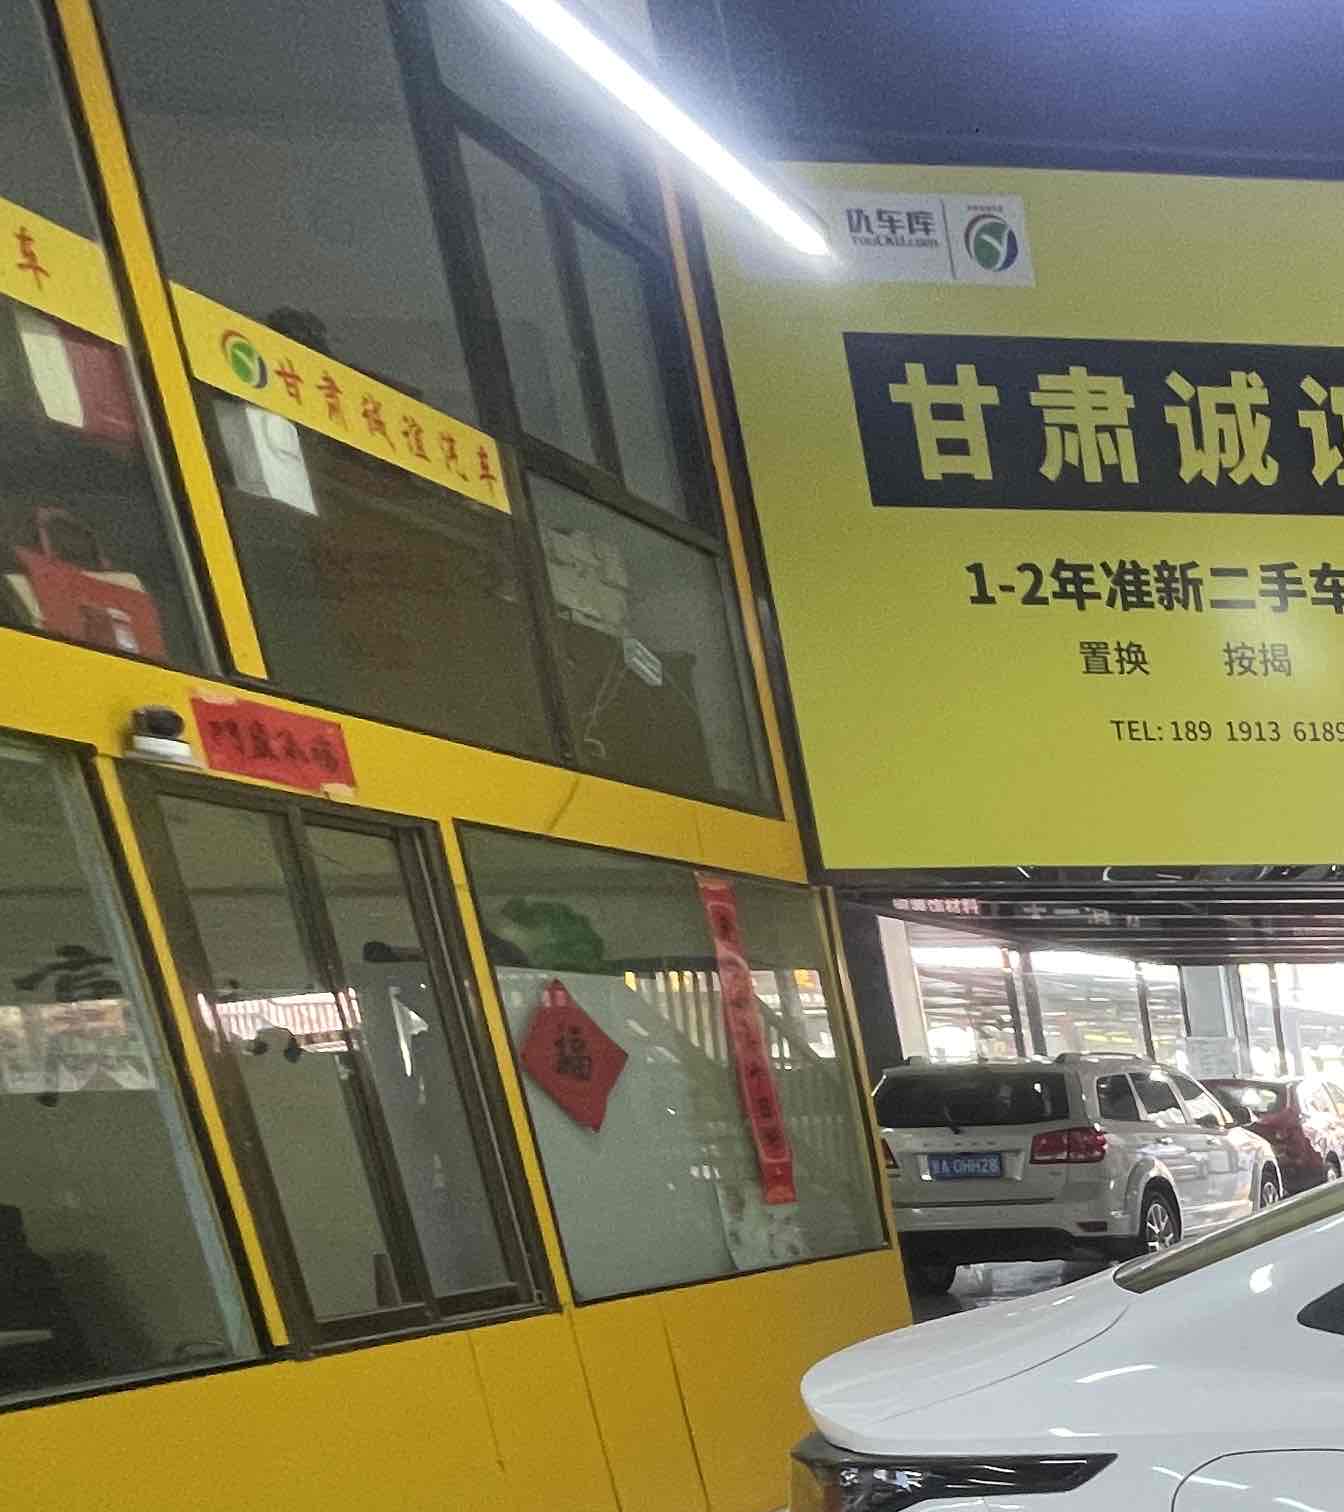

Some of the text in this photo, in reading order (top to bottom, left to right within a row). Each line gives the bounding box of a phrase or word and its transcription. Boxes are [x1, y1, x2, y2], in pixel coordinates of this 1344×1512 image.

[1078, 640, 1150, 678] 置换
[1222, 642, 1293, 679] 按揭
[1110, 719, 1164, 742] TEL:
[1170, 720, 1213, 743] 189
[1226, 720, 1281, 743] 1913
